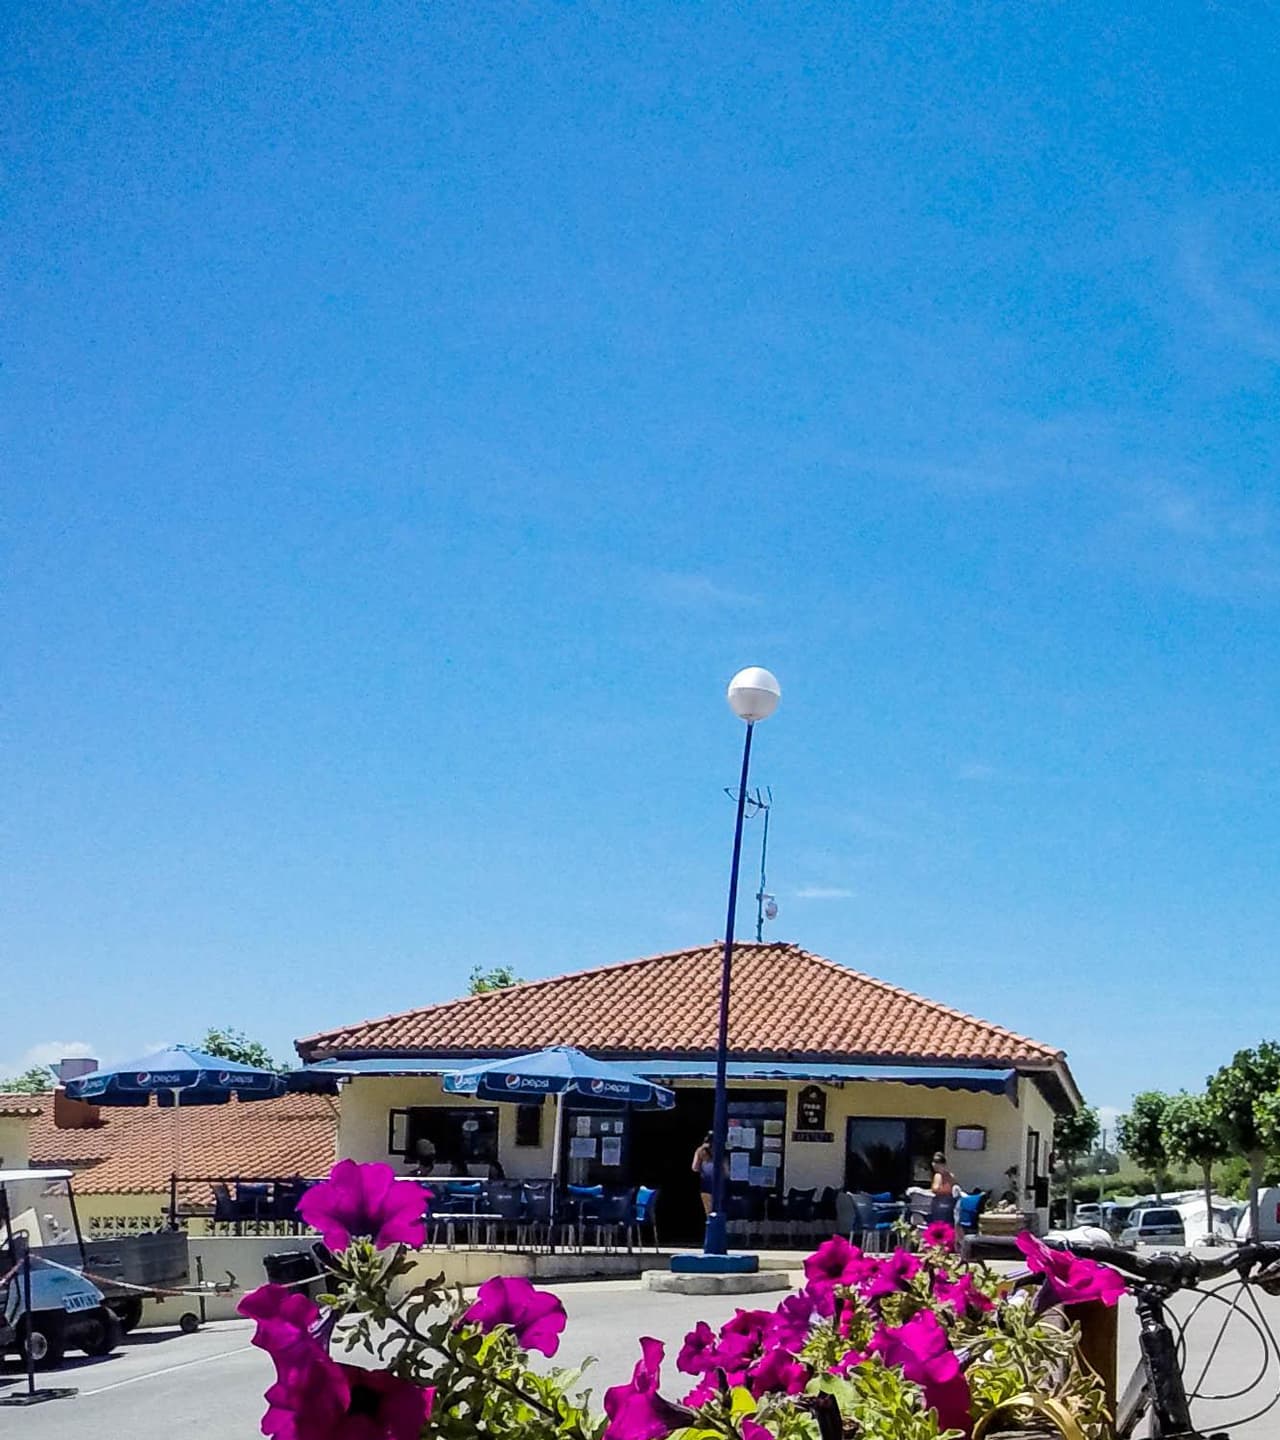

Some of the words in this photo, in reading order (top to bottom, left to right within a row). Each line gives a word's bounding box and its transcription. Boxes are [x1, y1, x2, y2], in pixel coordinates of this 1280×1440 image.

[152, 1073, 180, 1085] pepsi
[520, 1078, 549, 1089] pepsi
[604, 1083, 630, 1093] pepsi
